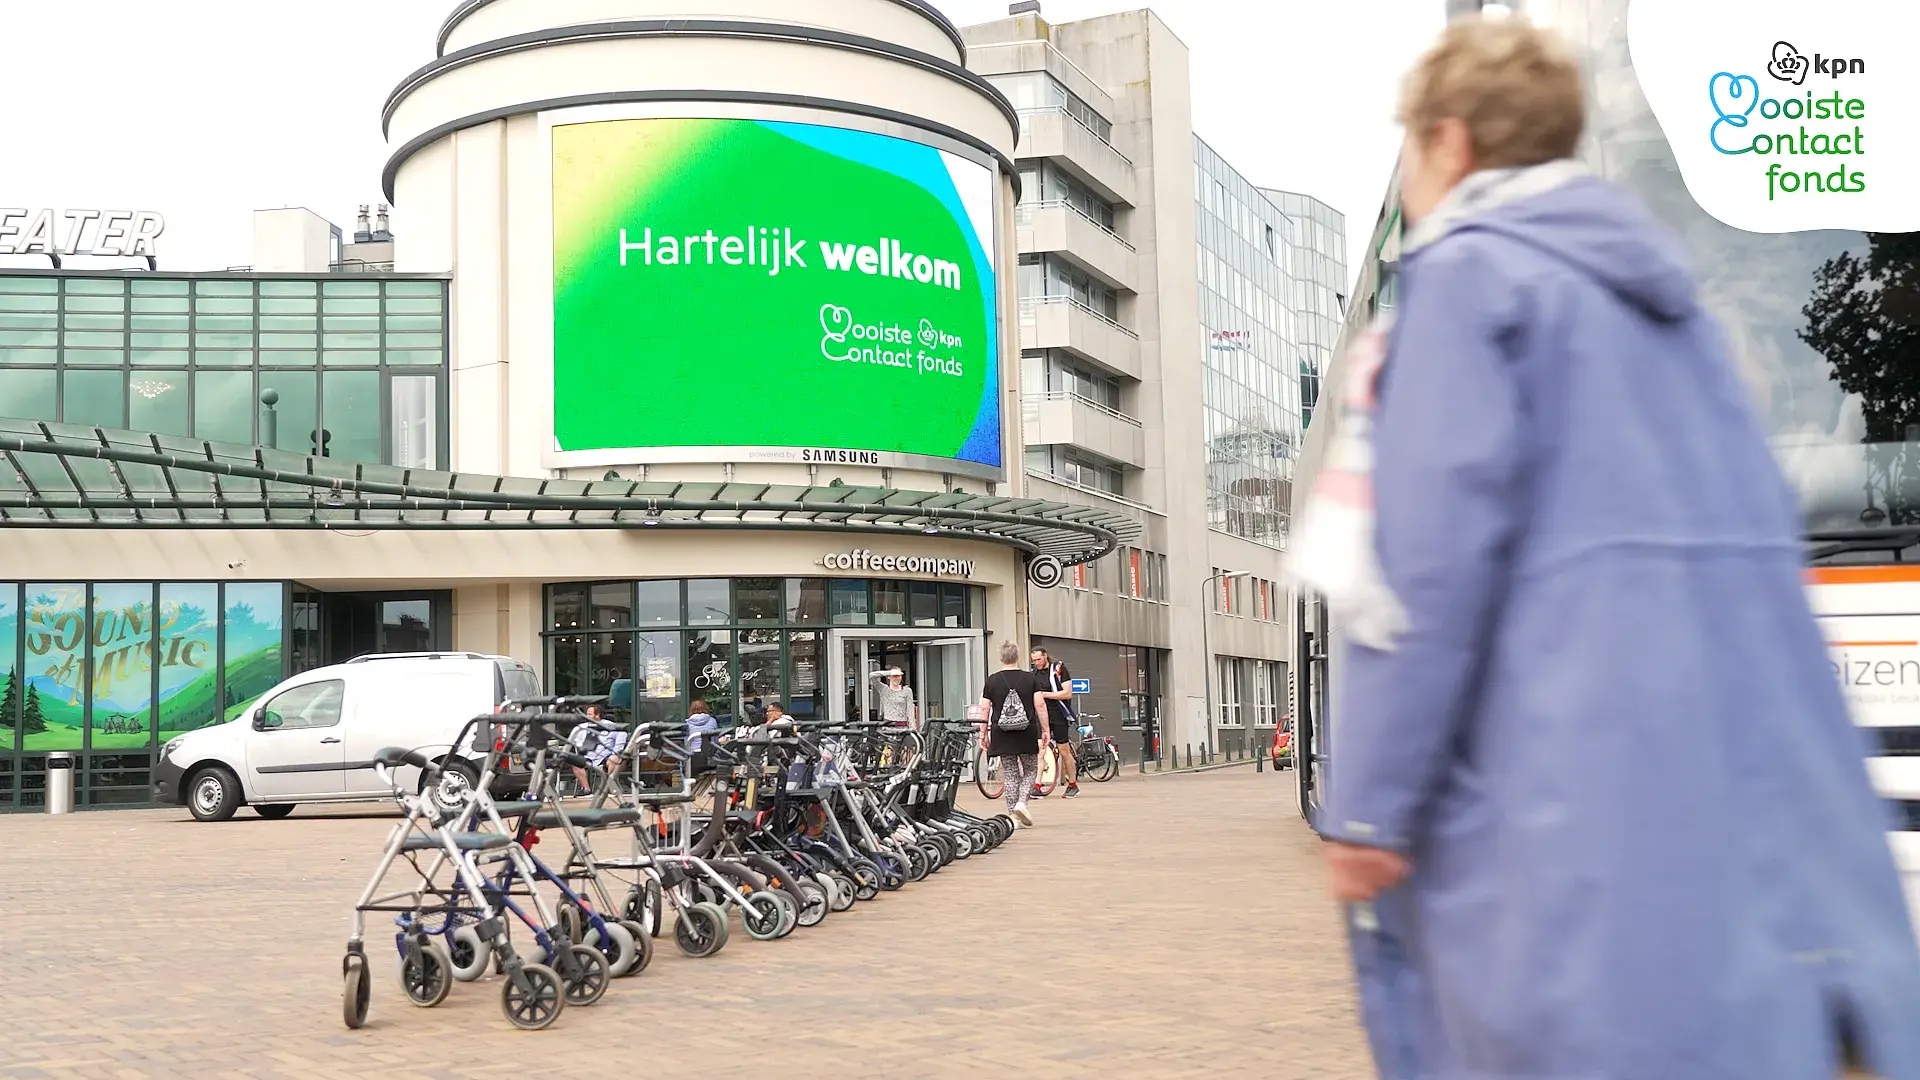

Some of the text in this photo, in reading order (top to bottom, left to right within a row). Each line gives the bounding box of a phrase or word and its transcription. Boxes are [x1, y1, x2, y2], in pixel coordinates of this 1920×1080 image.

[0, 207, 165, 257] EATER
[618, 225, 961, 290] Hartelijk welkom
[821, 333, 963, 376] Contact fonds
[939, 330, 963, 348] kpn
[802, 449, 878, 464] SAMSUNG
[823, 548, 977, 578] coffeecompany
[27, 601, 180, 656] SOUND
[45, 636, 209, 707] of MUSIC
